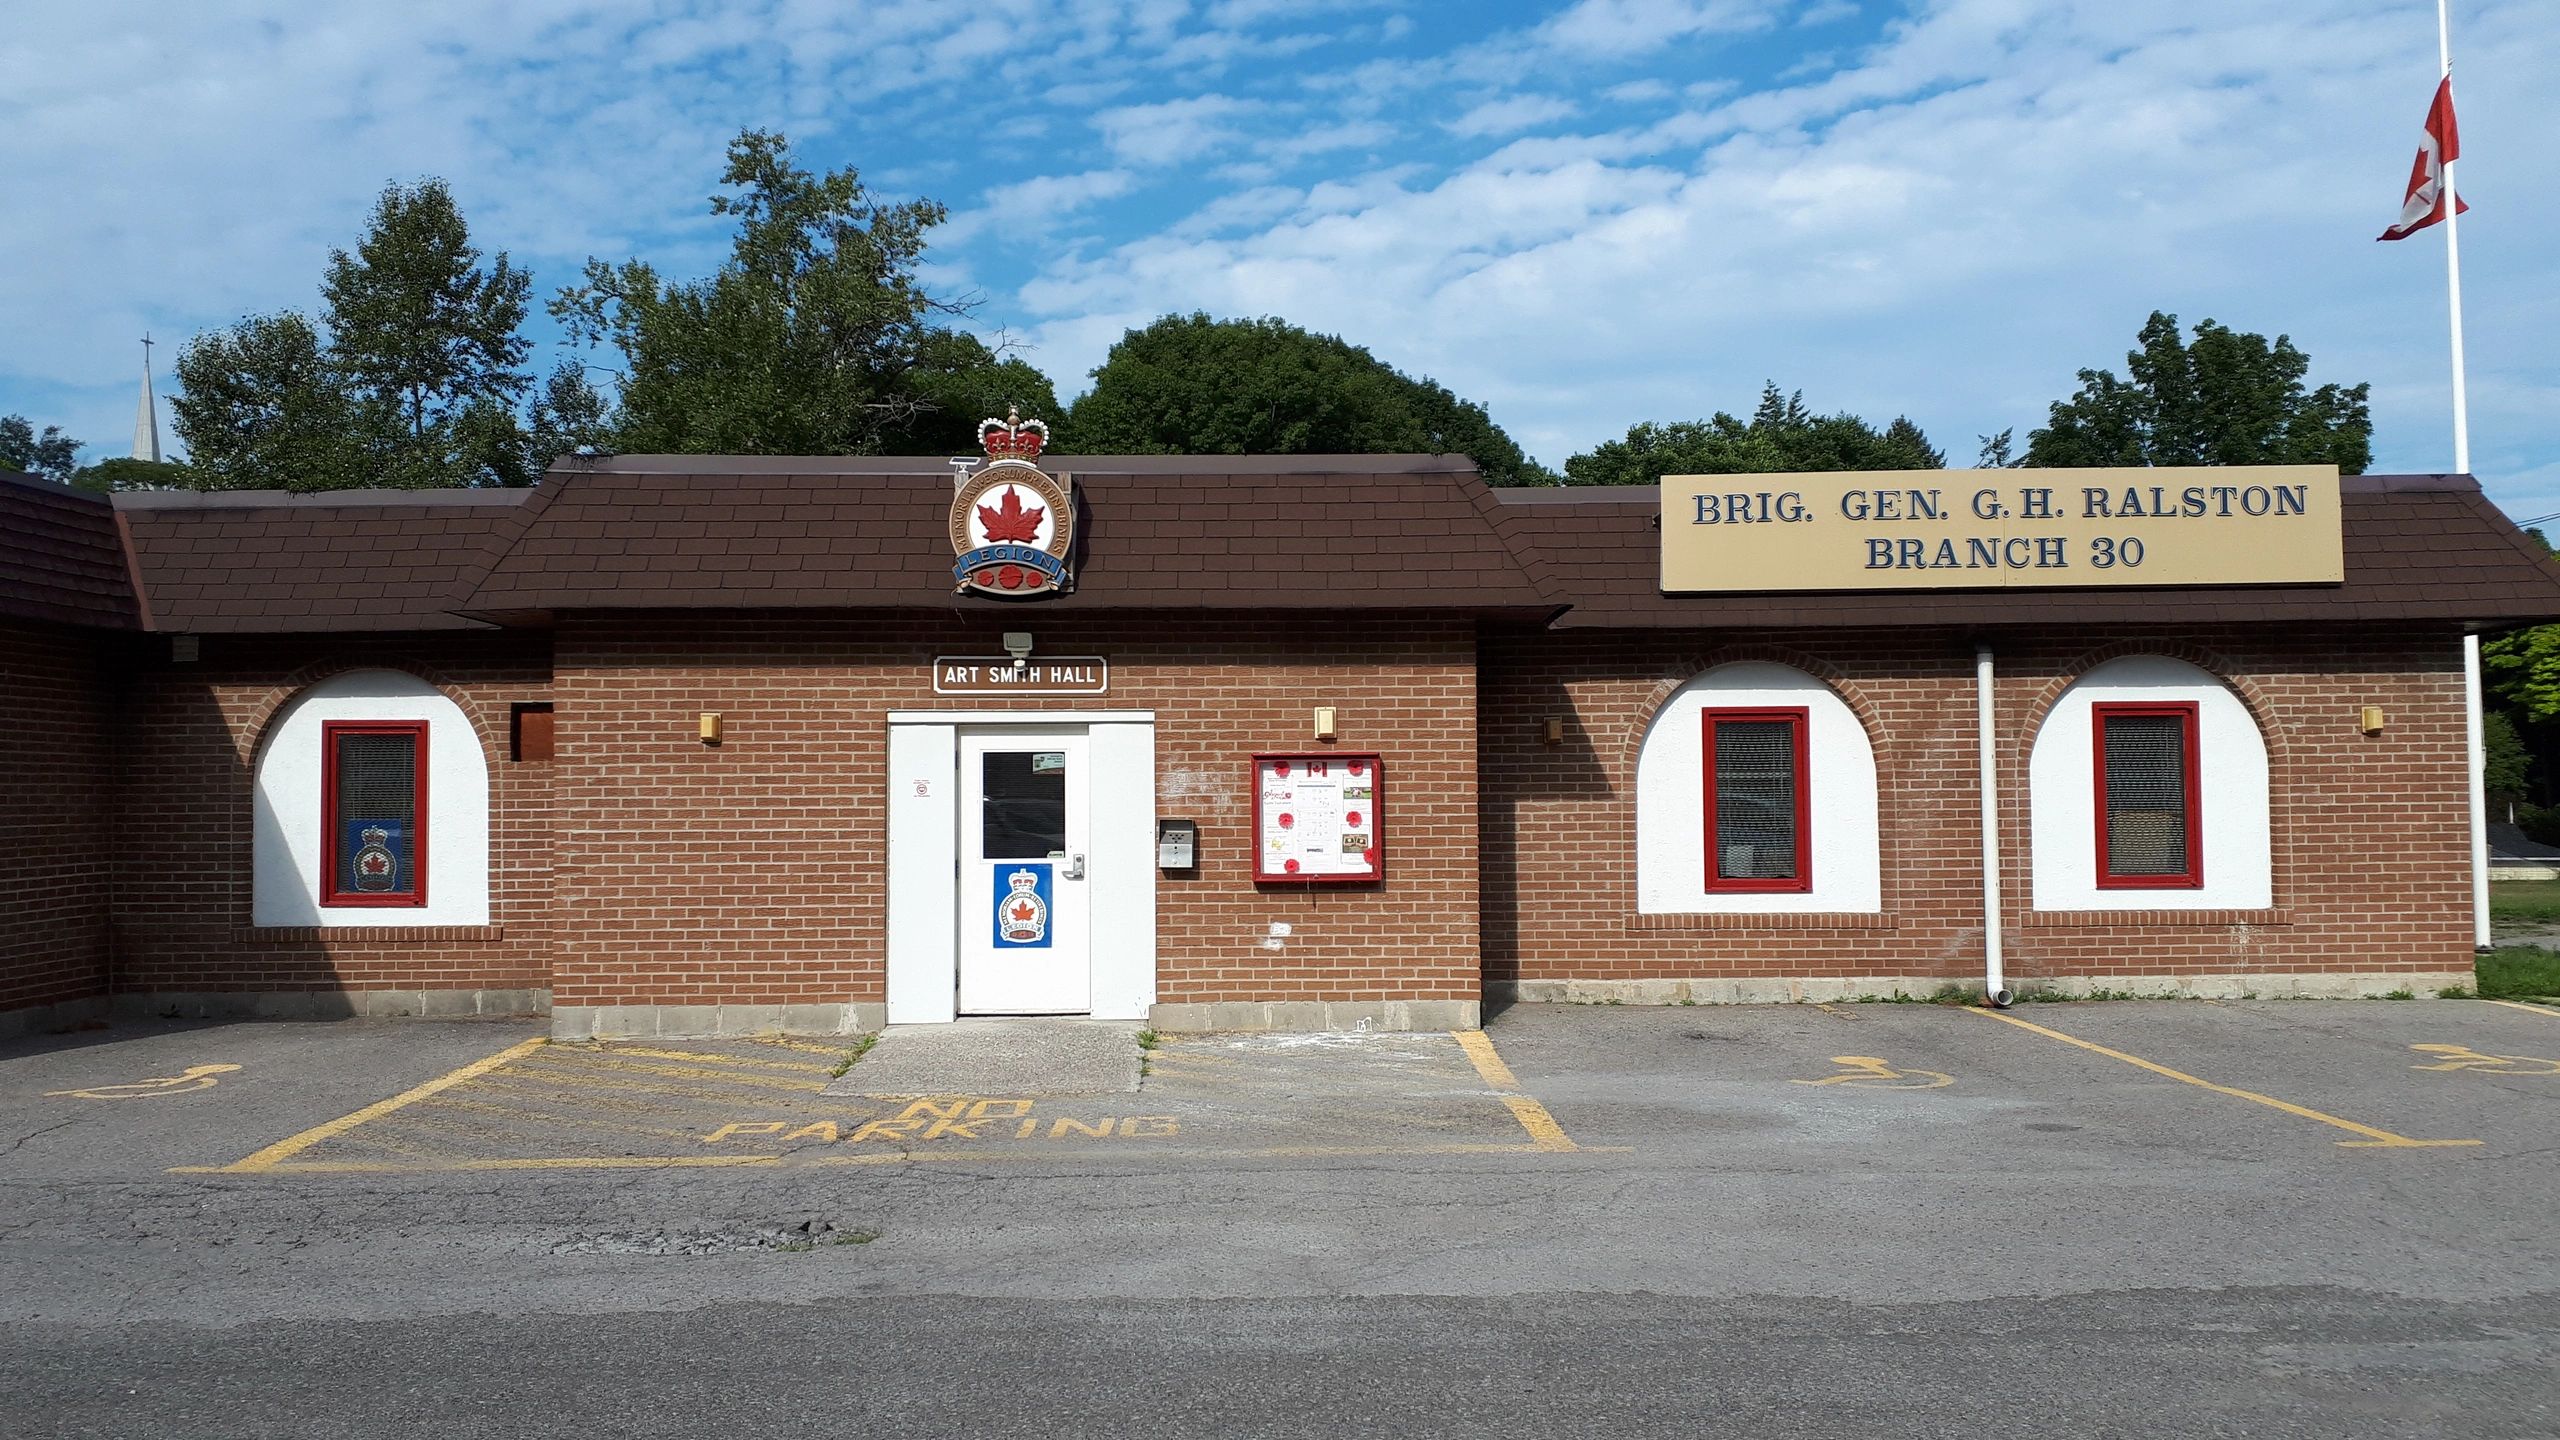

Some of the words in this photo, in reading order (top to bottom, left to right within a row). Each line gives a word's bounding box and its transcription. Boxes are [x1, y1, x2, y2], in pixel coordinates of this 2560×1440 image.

[954, 480, 982, 551] MEMORIAM
[1691, 491, 1814, 525] BRIG.
[1840, 489, 1949, 521] GEN.
[2081, 485, 2308, 518] RALSTON
[966, 548, 1055, 571] LEGION
[1864, 537, 2069, 569] BRANCH
[2090, 536, 2145, 568] 30
[945, 667, 979, 683] ART
[1051, 667, 1096, 683] HALL
[898, 1100, 1034, 1119] NO
[701, 1116, 1181, 1142] PARKING
